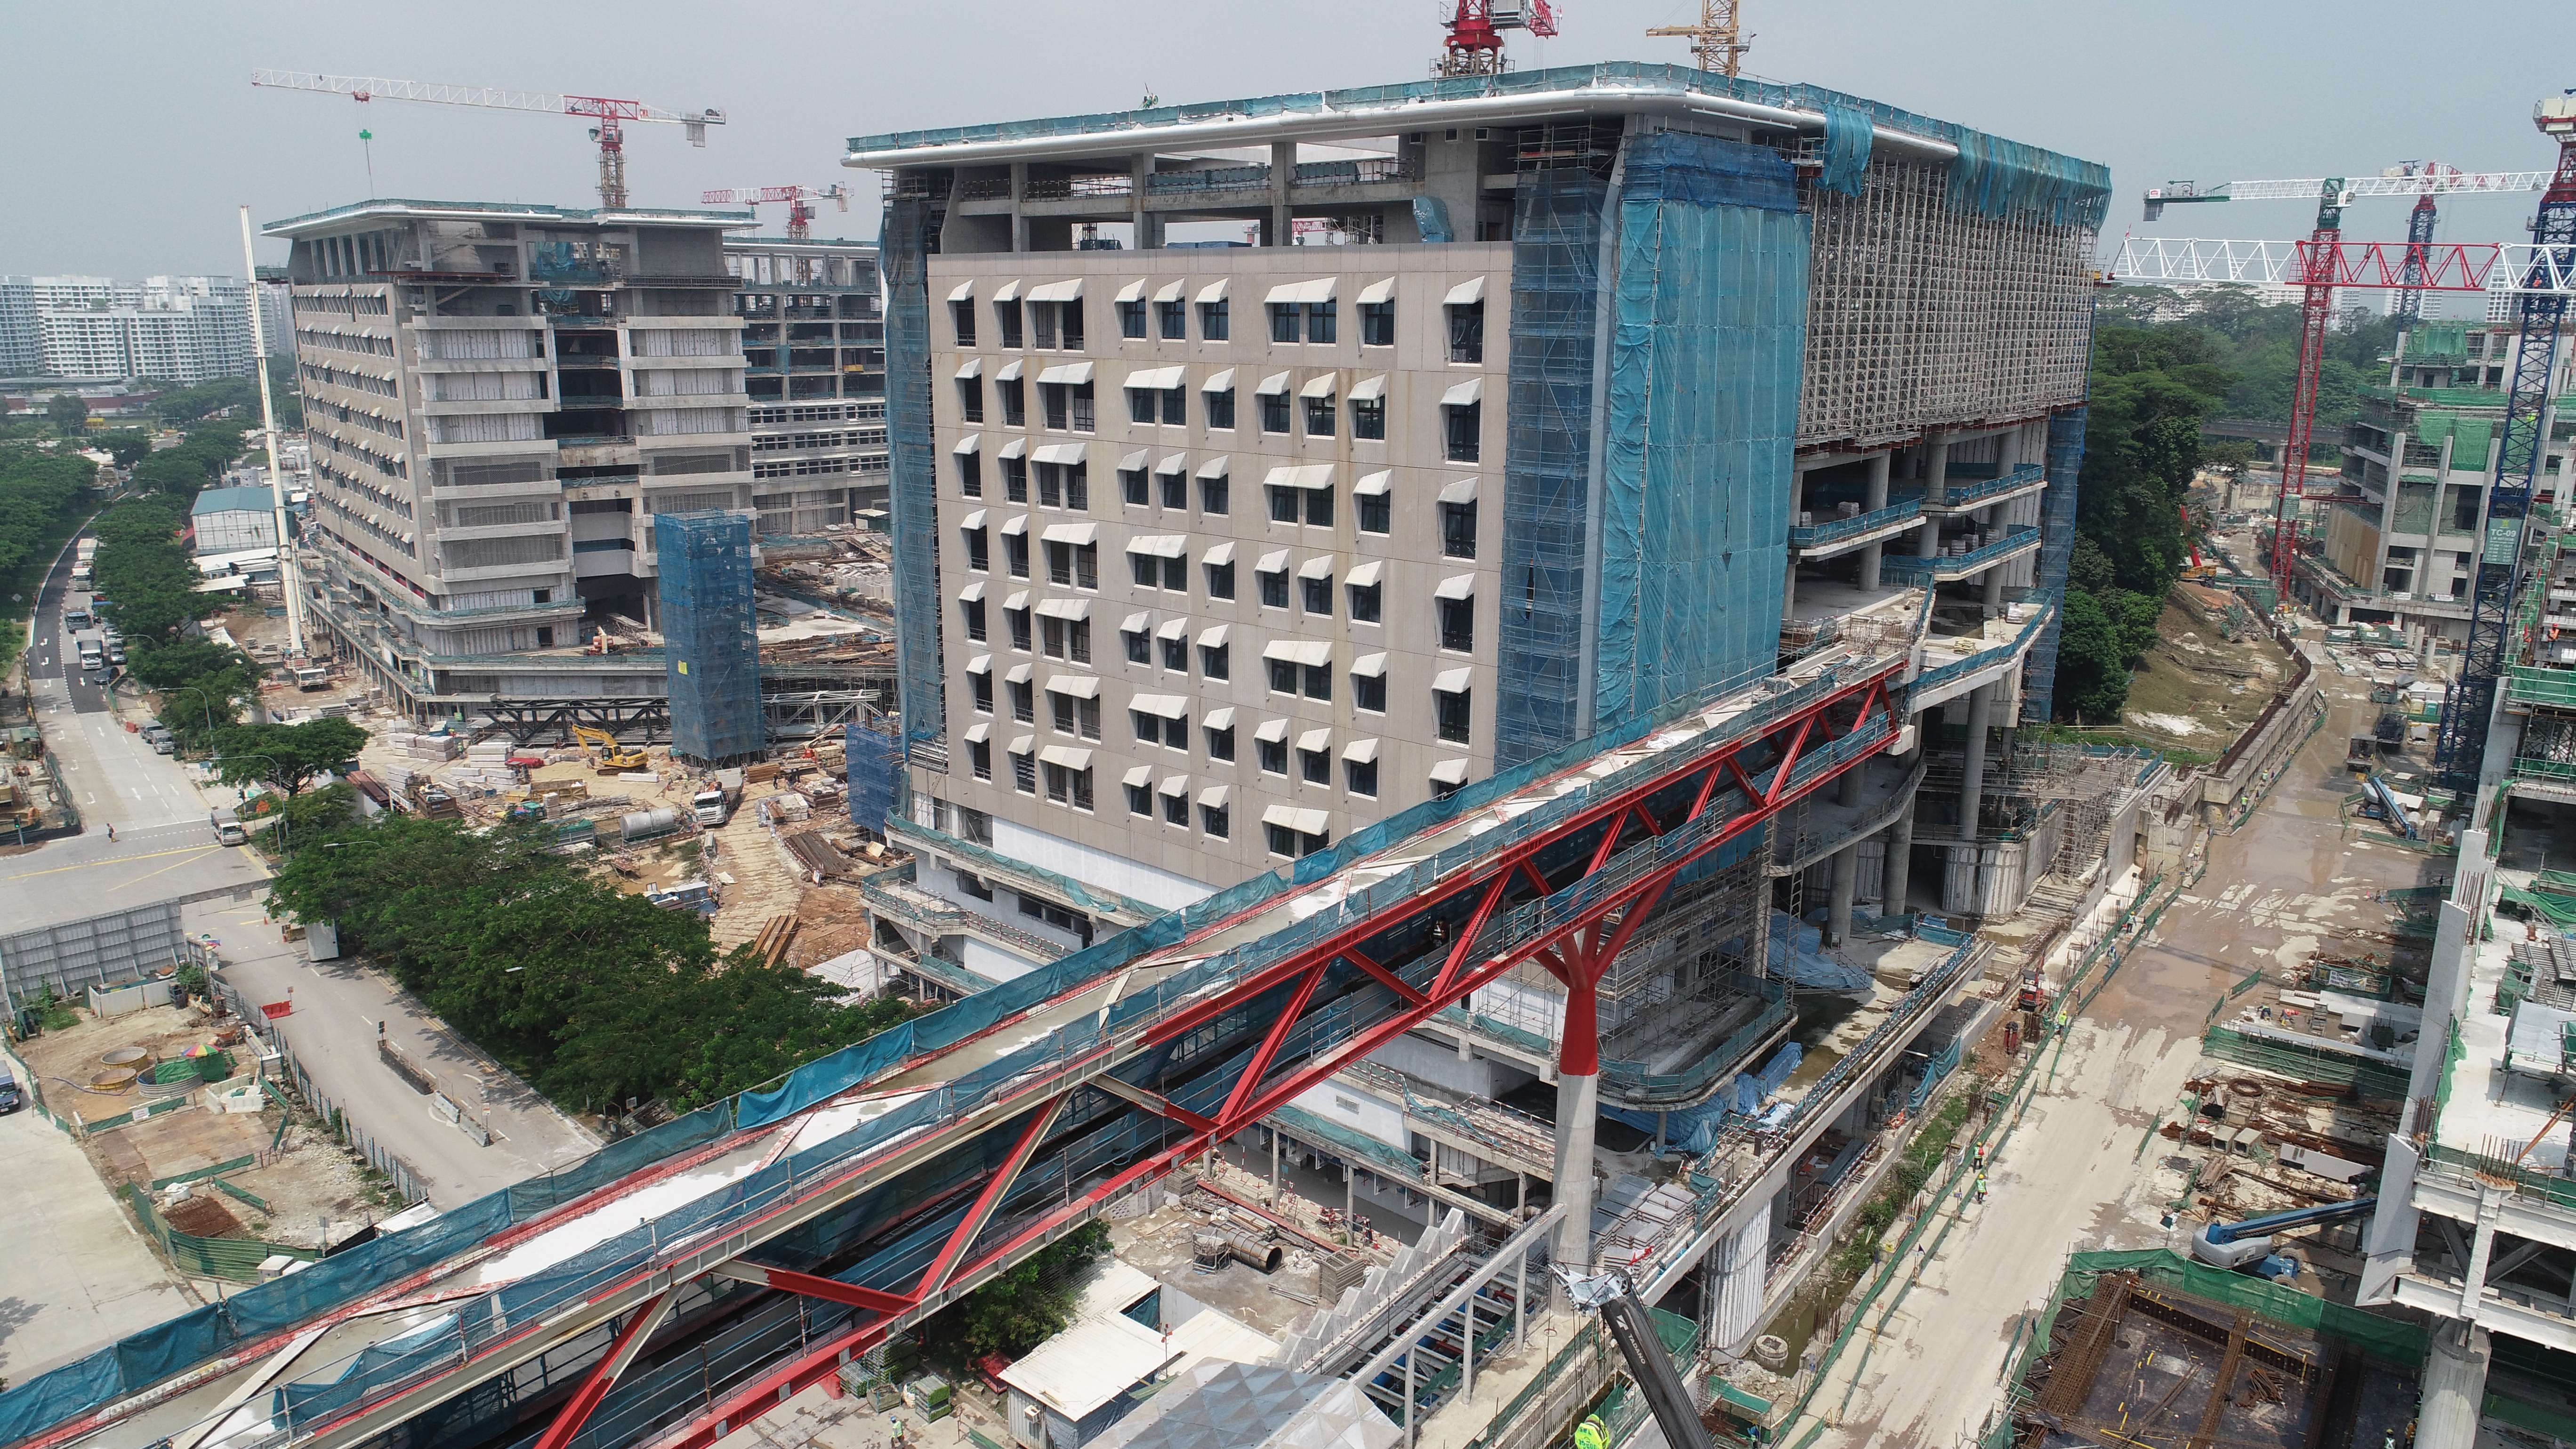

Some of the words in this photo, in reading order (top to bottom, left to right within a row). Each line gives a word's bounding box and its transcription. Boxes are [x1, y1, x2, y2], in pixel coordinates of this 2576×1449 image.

[2491, 529, 2516, 537] TC-09
[1628, 1333, 1646, 1364] TADANO
[1579, 1426, 1592, 1435] SWL
